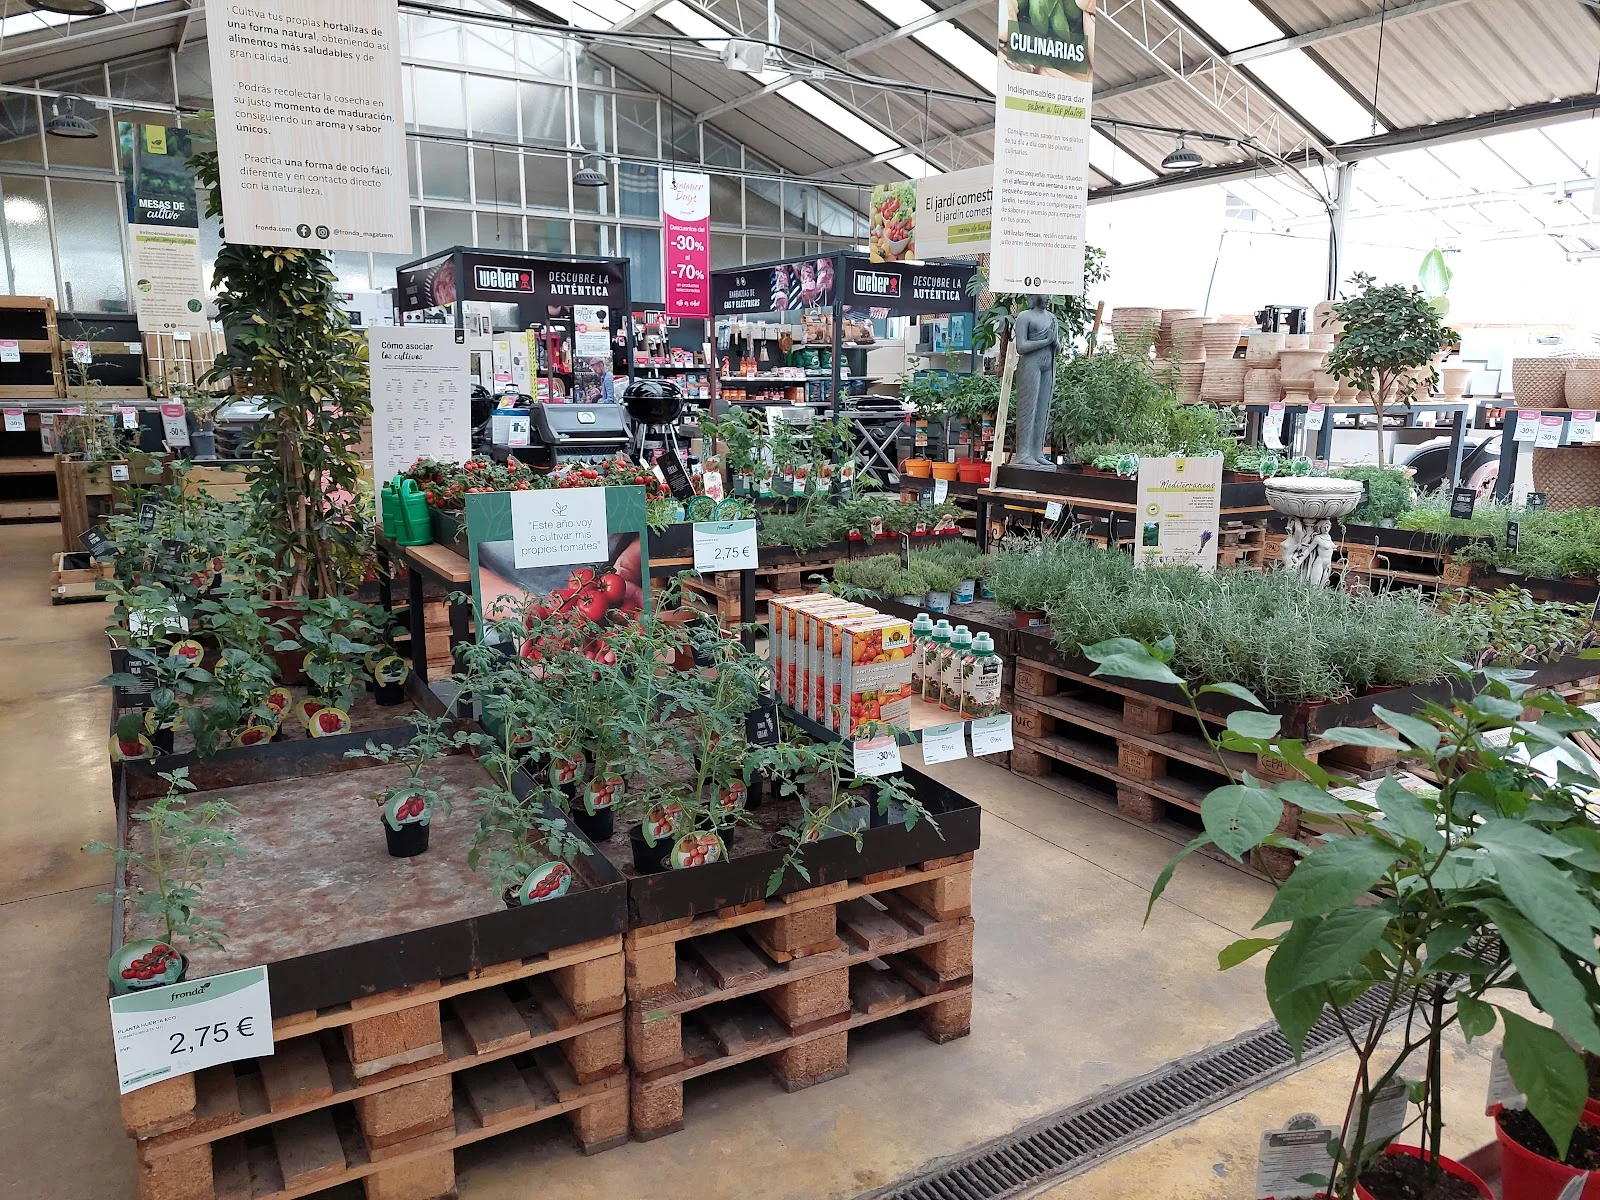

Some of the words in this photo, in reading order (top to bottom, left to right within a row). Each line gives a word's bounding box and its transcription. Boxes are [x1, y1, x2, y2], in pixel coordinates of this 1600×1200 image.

[232, 6, 265, 19] Cultiva
[268, 12, 282, 22] tus
[286, 15, 320, 28] propias
[324, 20, 368, 35] hortalizas
[372, 28, 382, 36] de
[228, 20, 246, 30] una
[250, 22, 278, 35] forma
[282, 29, 318, 42] natural,
[322, 34, 374, 50] obteniendo
[378, 42, 390, 50] así
[228, 34, 278, 48] alimentos
[281, 42, 300, 52] más
[304, 45, 353, 59] saludables
[364, 53, 374, 62] de
[1010, 32, 1084, 62] CULINARIAS
[230, 50, 252, 58] gran
[254, 52, 292, 64] calidad.
[238, 82, 272, 94] Podrás
[274, 88, 320, 100] recolectar
[324, 92, 332, 102] la
[334, 95, 370, 106] cosecha
[1008, 84, 1056, 99] Indispensables
[1074, 95, 1084, 103] dar
[247, 97, 271, 108] justo
[274, 102, 320, 114] momento
[324, 106, 334, 114] de
[338, 110, 394, 123] maduración,
[236, 110, 298, 124] consiguiendo
[316, 120, 346, 130] aroma
[356, 122, 382, 134] sabor
[236, 122, 271, 135] únicos.
[244, 154, 282, 165] Practica
[285, 159, 302, 167] una
[306, 160, 334, 170] forma
[336, 163, 347, 172] de
[350, 165, 368, 174] ocio
[371, 166, 392, 176] fácil,
[240, 167, 283, 178] diferente
[308, 174, 348, 184] contacto
[350, 177, 382, 188] directo
[261, 182, 269, 190] la
[272, 185, 323, 196] naturaleza.
[139, 199, 171, 210] MESAS
[173, 202, 185, 210] DE
[926, 198, 932, 210] El
[934, 193, 955, 212] jardí
[147, 207, 180, 220] cultivo
[936, 212, 942, 222] El
[943, 210, 964, 224] jardín
[256, 224, 292, 232] fronda.com
[670, 235, 704, 252] -30%
[479, 267, 519, 288] weber
[550, 272, 594, 284] DESCUBRE
[599, 274, 609, 284] LA
[671, 264, 704, 280] -70%
[550, 283, 608, 296] AUTÉNTICA
[858, 272, 890, 293] weber
[913, 276, 950, 288] DESCUBRE
[952, 279, 962, 288] LA
[914, 288, 960, 300] AUTÉNTICA
[556, 520, 574, 528] año
[576, 520, 592, 528] voy
[540, 532, 572, 542] cultivar
[576, 530, 592, 539] mis
[522, 545, 558, 556] propios
[714, 547, 739, 560] 2,75
[742, 546, 750, 558] €
[877, 751, 896, 760] -30%
[170, 986, 205, 1002] fronda
[118, 1024, 140, 1034] PLANTA
[141, 1019, 164, 1027] HUERTA
[169, 1021, 228, 1054] 2,75
[236, 1016, 254, 1036] €
